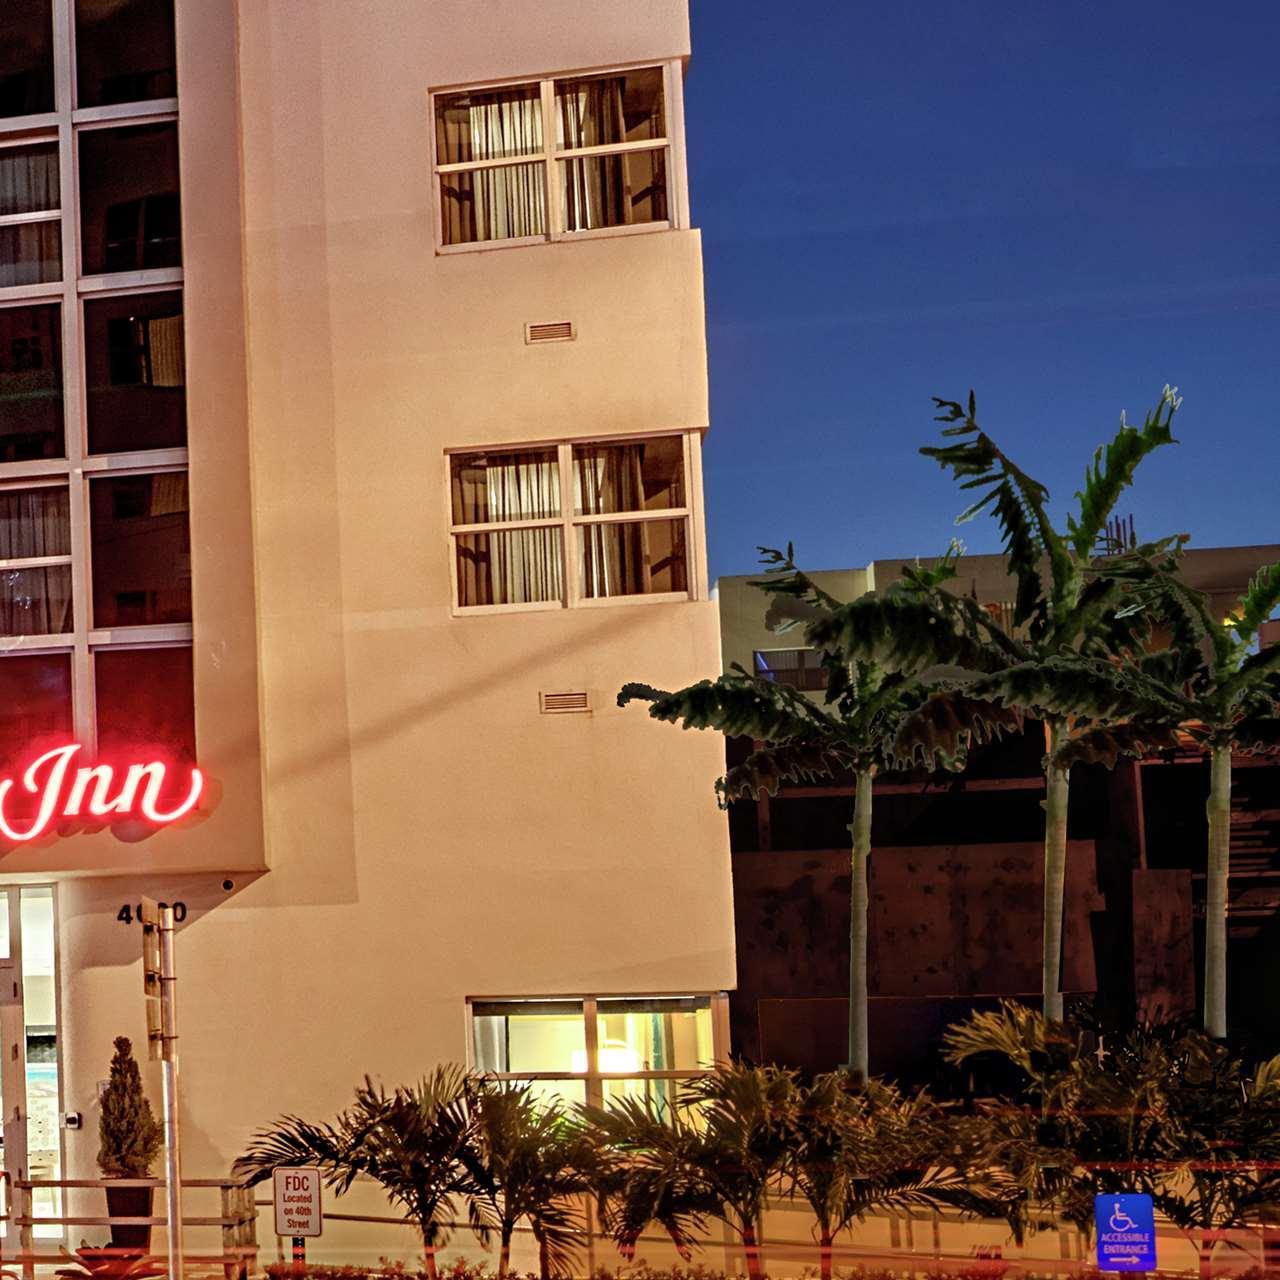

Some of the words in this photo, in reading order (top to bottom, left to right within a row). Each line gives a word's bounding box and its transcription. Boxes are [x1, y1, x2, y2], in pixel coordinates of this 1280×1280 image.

[117, 901, 187, 925] 40
[285, 1175, 310, 1192] FDC
[282, 1193, 313, 1204] Located
[283, 1207, 294, 1216] on
[295, 1206, 313, 1216] 40th
[287, 1218, 310, 1229] Street
[1101, 1232, 1150, 1242] ACCESSIBLE
[1103, 1244, 1149, 1255] ENTRANCE
